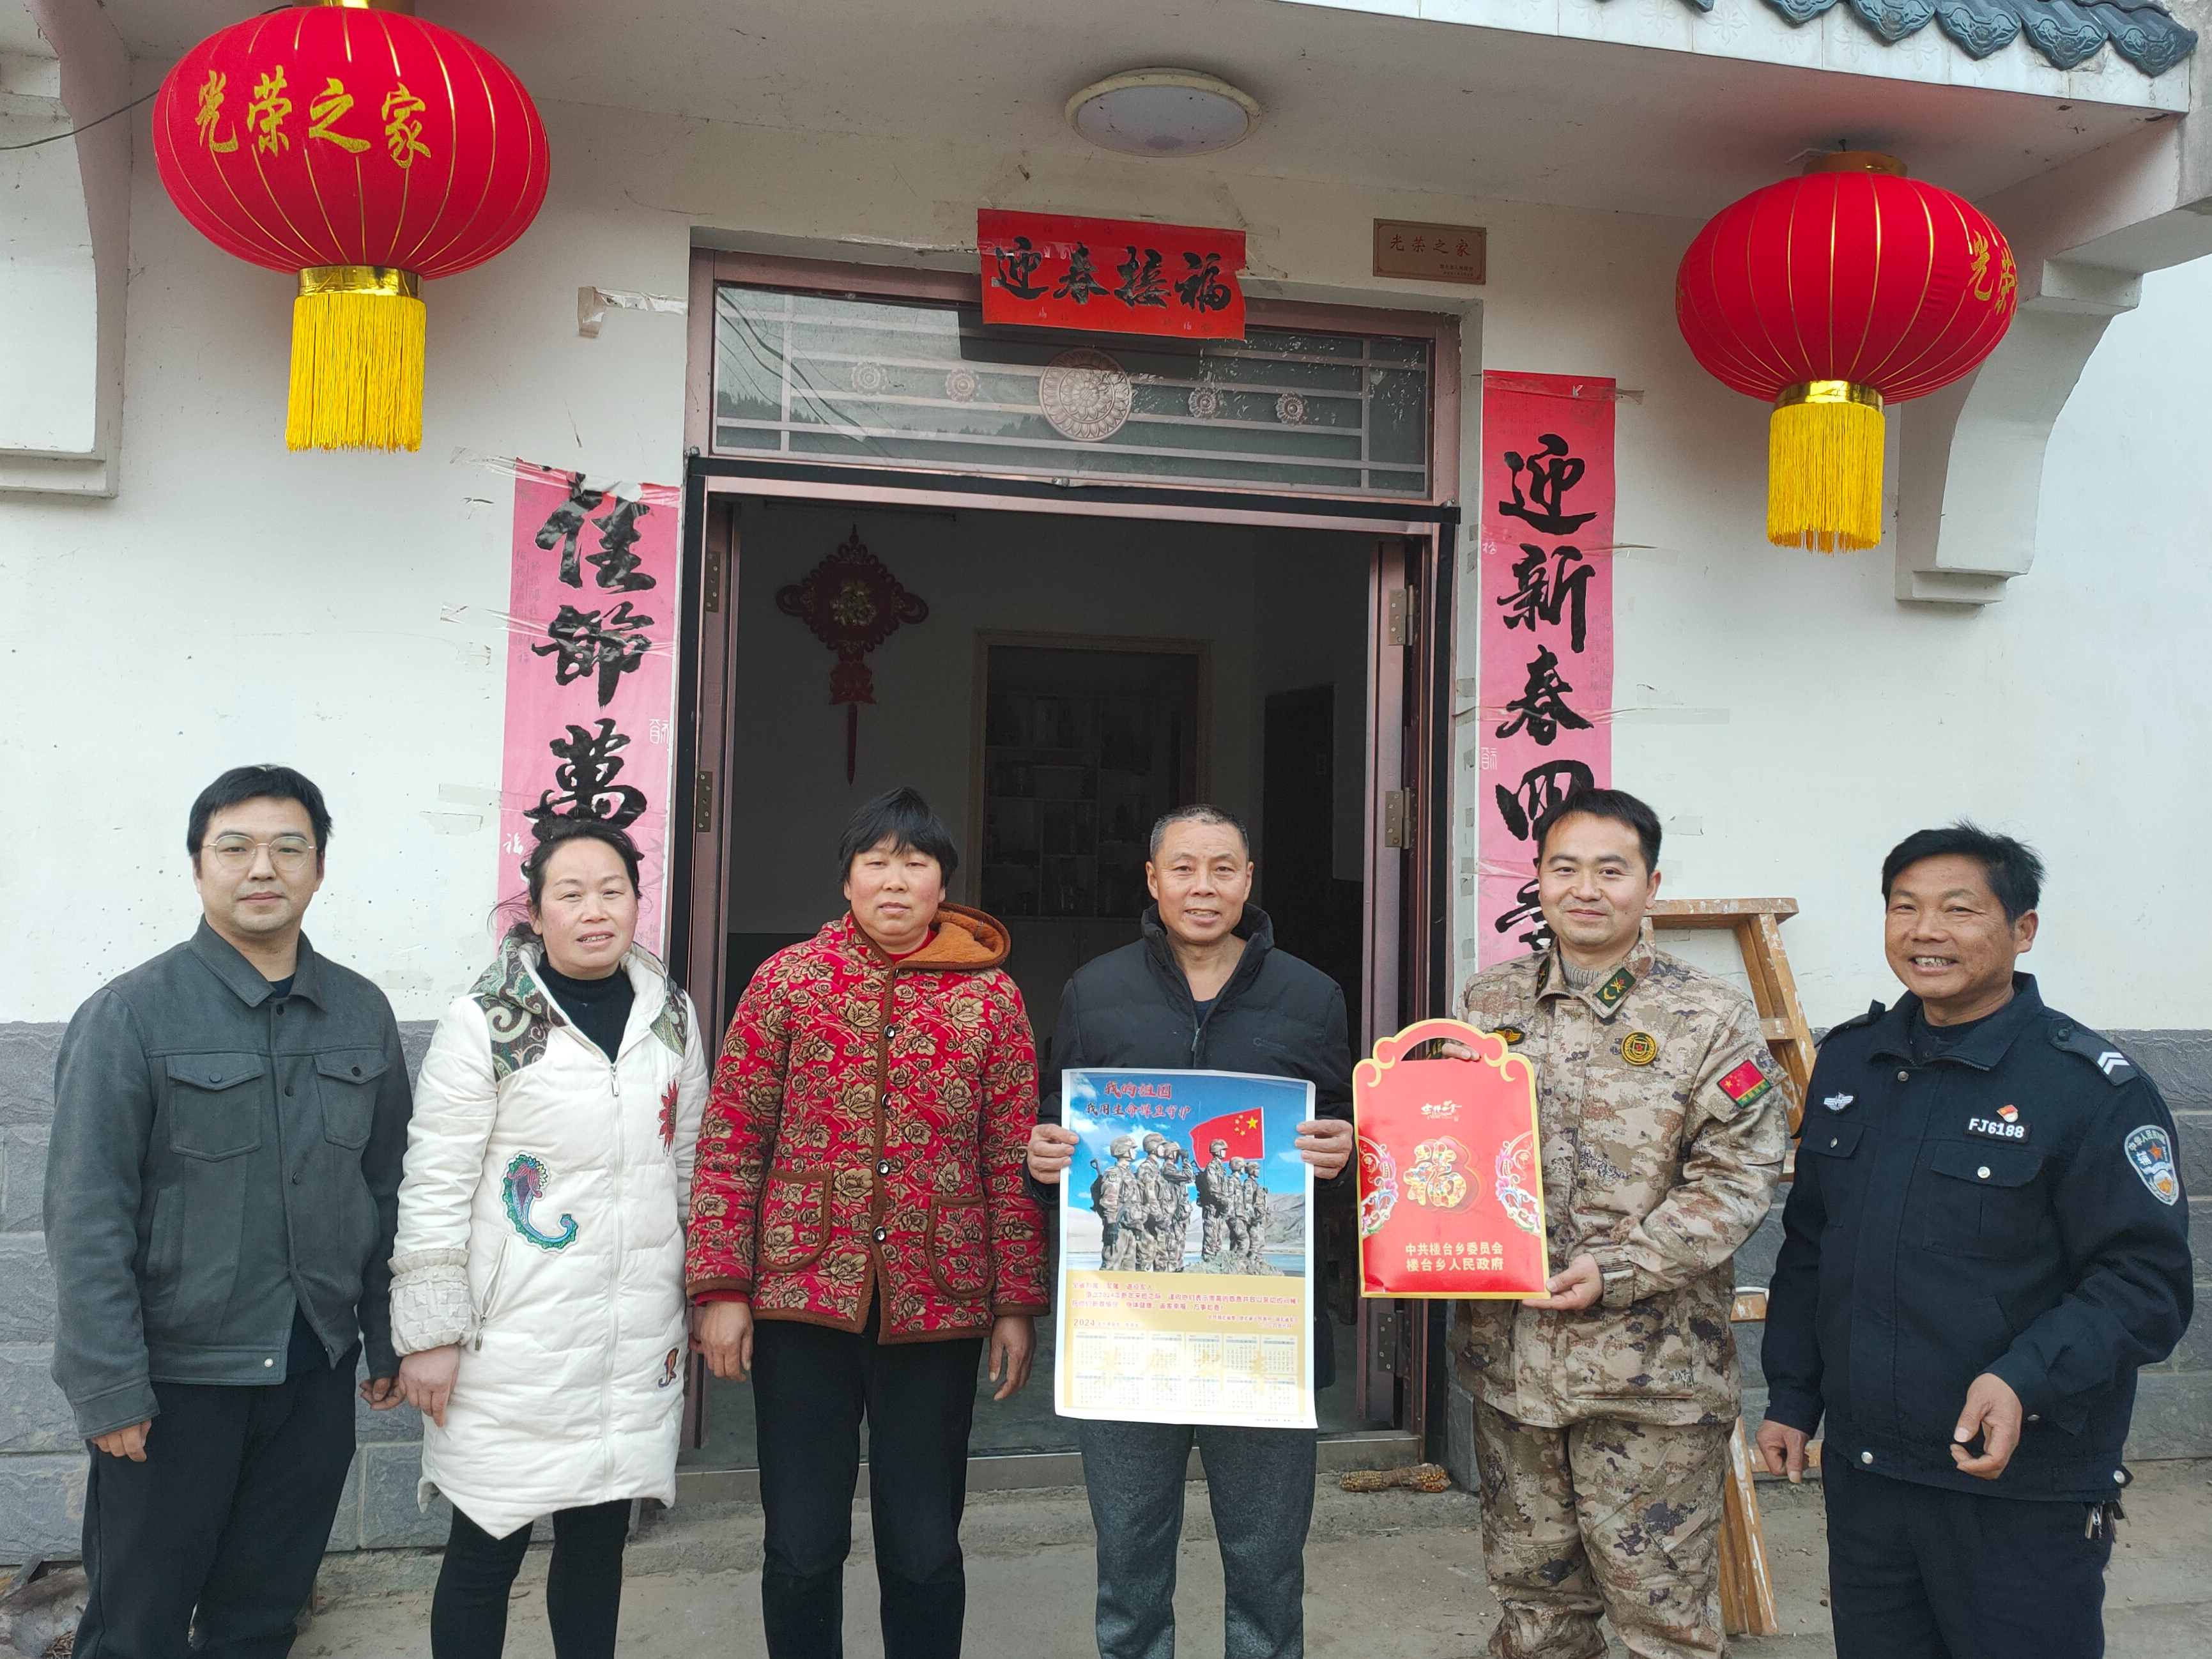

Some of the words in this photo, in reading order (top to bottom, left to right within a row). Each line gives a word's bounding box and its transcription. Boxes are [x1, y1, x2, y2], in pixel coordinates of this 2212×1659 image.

[195, 65, 431, 168] 光荣之家
[1390, 233, 1471, 258] 光荣之家
[994, 236, 1231, 313] 迎春接福
[1967, 228, 2018, 316] 光荣
[1104, 1081, 1172, 1099] 我的祖国
[1086, 1102, 1191, 1120] 我用生命捍卫守护
[1969, 1118, 2025, 1138] FJ6188
[1404, 1141, 1467, 1208] 福
[1406, 1242, 1503, 1256] 中共楼台乡委员会
[1406, 1257, 1503, 1272] 楼台乡人民政府
